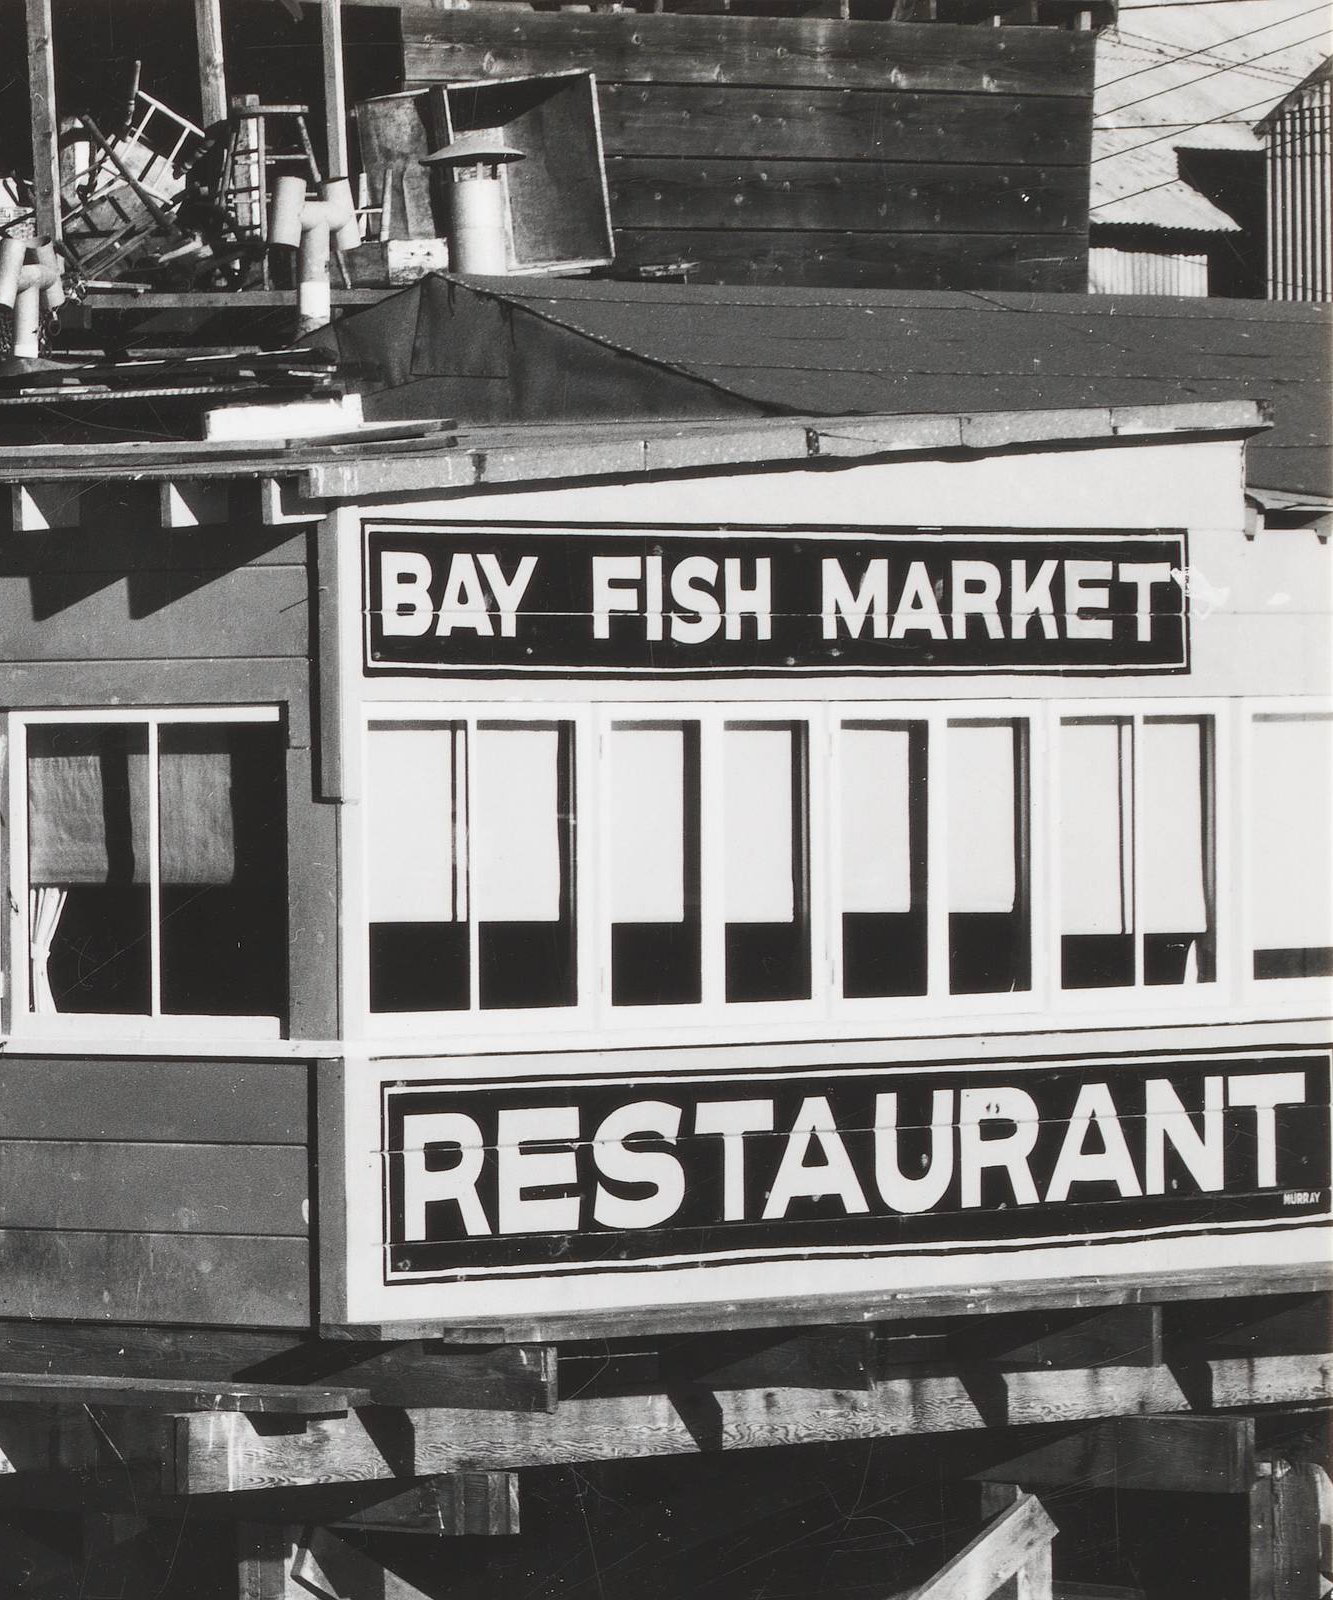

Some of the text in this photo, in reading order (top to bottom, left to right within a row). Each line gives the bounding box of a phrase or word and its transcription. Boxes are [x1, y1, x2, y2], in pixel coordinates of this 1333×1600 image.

[380, 550, 1173, 645] BAY FISH MARKET
[402, 1071, 1307, 1243] RESTAURANT
[1282, 1191, 1322, 1206] MURRAY
